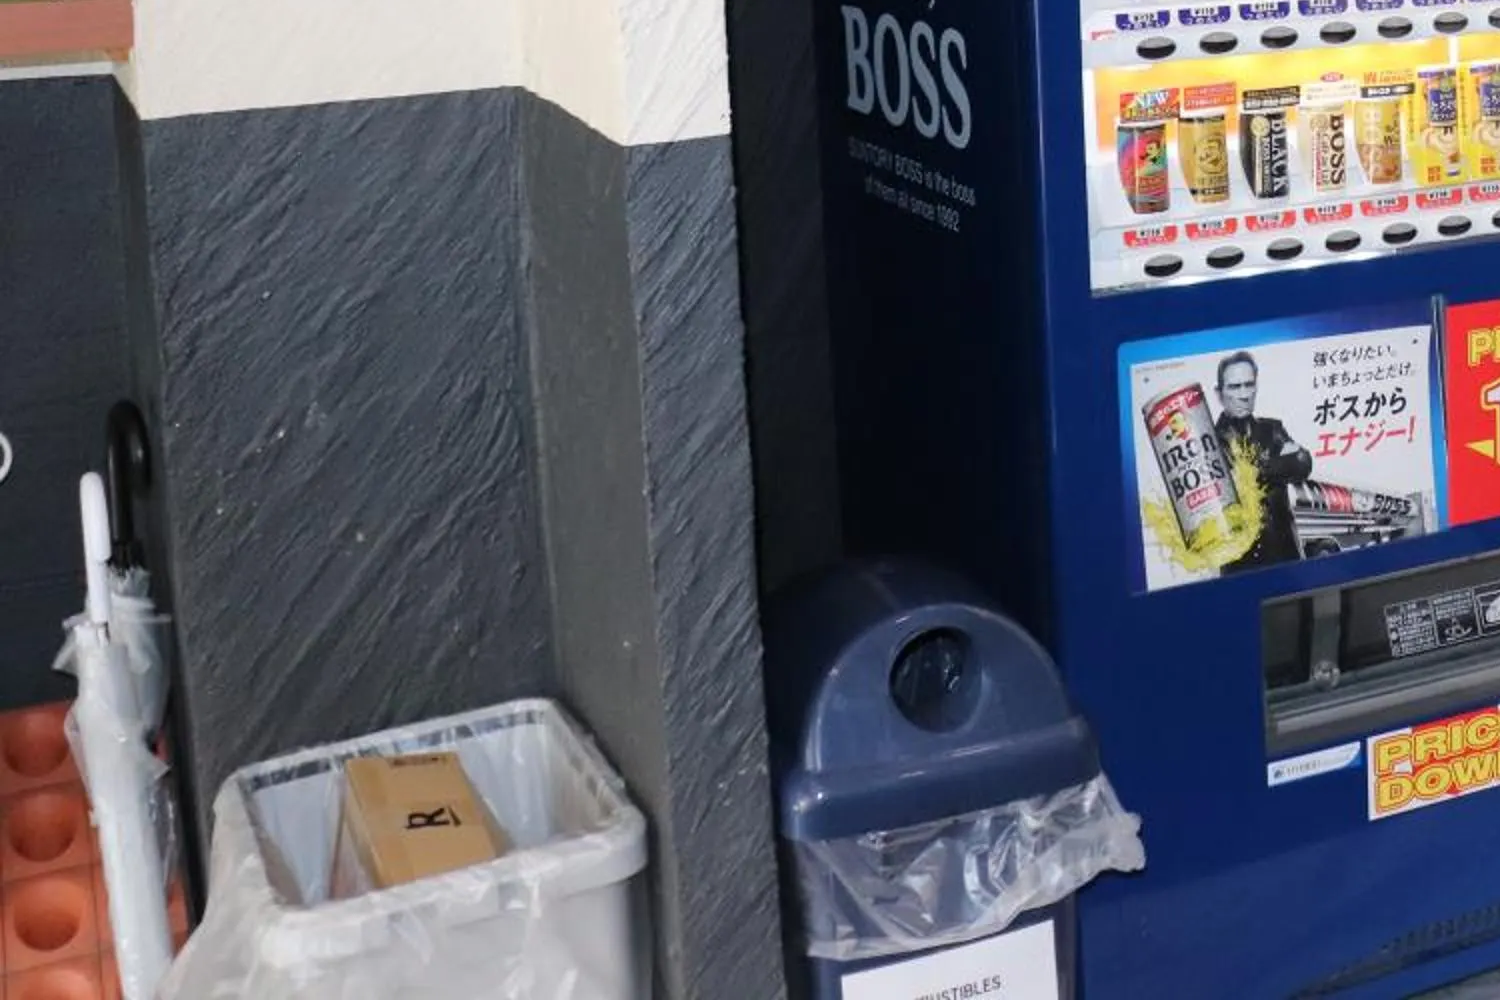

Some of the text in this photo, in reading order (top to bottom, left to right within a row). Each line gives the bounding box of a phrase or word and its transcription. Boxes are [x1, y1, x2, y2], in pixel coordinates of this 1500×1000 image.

[841, 4, 972, 149] BOSS
[1329, 112, 1345, 186] BOSS
[1314, 387, 1407, 425] ボスから
